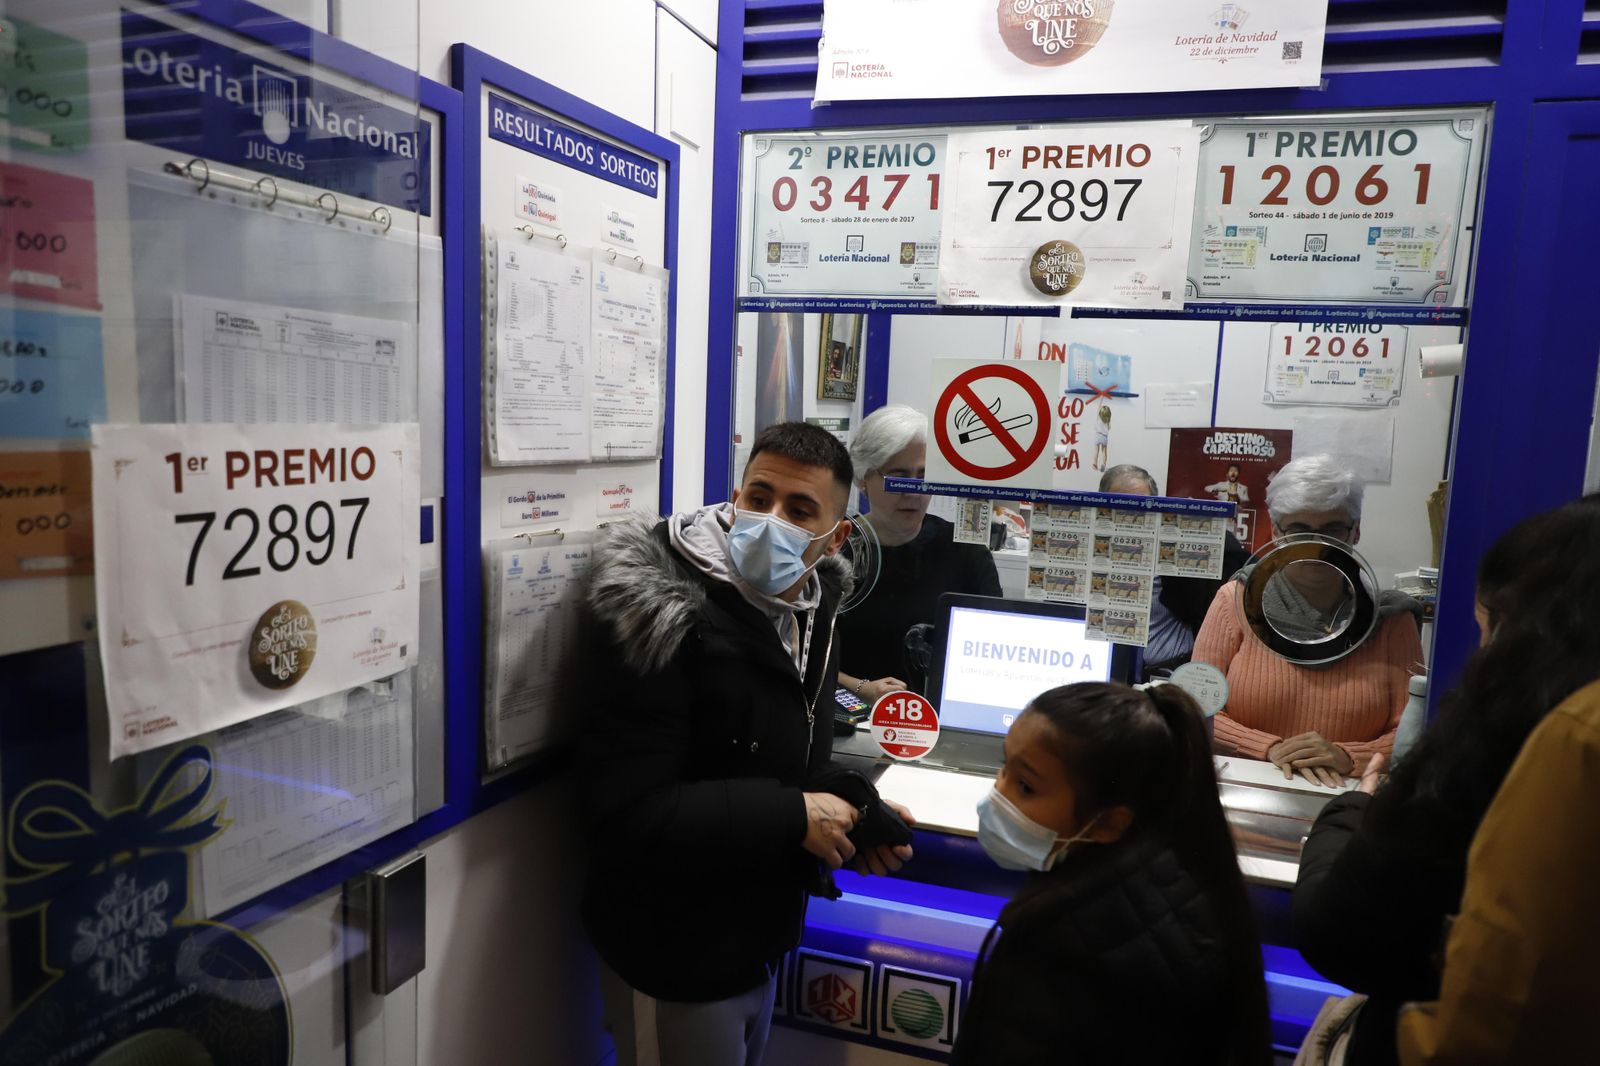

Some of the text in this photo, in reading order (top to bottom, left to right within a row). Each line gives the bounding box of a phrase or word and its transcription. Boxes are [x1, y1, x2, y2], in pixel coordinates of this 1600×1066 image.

[1034, 3, 1062, 20] QUE
[1065, 0, 1095, 19] NOS
[1025, 18, 1078, 55] UNE
[1215, 33, 1229, 44] de
[1230, 30, 1279, 43] Navidad
[1189, 45, 1260, 57] 22 de diciembre
[304, 97, 419, 160] Nacional
[245, 140, 305, 171] JUEVES
[494, 107, 657, 189] RESULTADOS SORTEOS
[826, 142, 936, 170] PREMIO
[986, 143, 1152, 171] 1er PREMIO
[1246, 128, 1418, 158] 1er PREMIO
[772, 173, 941, 212] 03471
[1219, 163, 1432, 206] 12061
[987, 178, 1143, 223] 72897
[831, 215, 853, 223] sábado
[1249, 211, 1273, 219] Sorteo
[1275, 211, 1284, 219] 44
[1292, 211, 1320, 220] sábado
[1328, 212, 1338, 220] de
[1340, 212, 1360, 221] junio
[1362, 212, 1372, 220] de
[1374, 211, 1394, 219] 2019
[851, 253, 890, 262] Nacional
[1311, 253, 1361, 262] Nacional
[1243, 309, 1279, 317] Apuestas
[1376, 311, 1414, 319] Apuestas
[1284, 336, 1390, 359] 12061
[1202, 443, 1276, 458] CAPRICHOSO
[1205, 436, 1215, 444] EL
[1214, 431, 1266, 447] DESTINO
[165, 446, 376, 494] 1er PREMIO
[513, 495, 528, 503] Gordo
[928, 484, 958, 493] Apuestas
[971, 487, 994, 495] Estado
[1036, 491, 1069, 501] Apuestas
[1083, 495, 1107, 503] Estado
[1153, 501, 1187, 510] Apuestas
[1202, 504, 1228, 513] Estado
[174, 497, 370, 587] 72897
[258, 615, 308, 653] SORTEO
[266, 650, 299, 680] UNE
[963, 640, 1093, 671] BIENVENIDO A
[885, 698, 923, 721] +18
